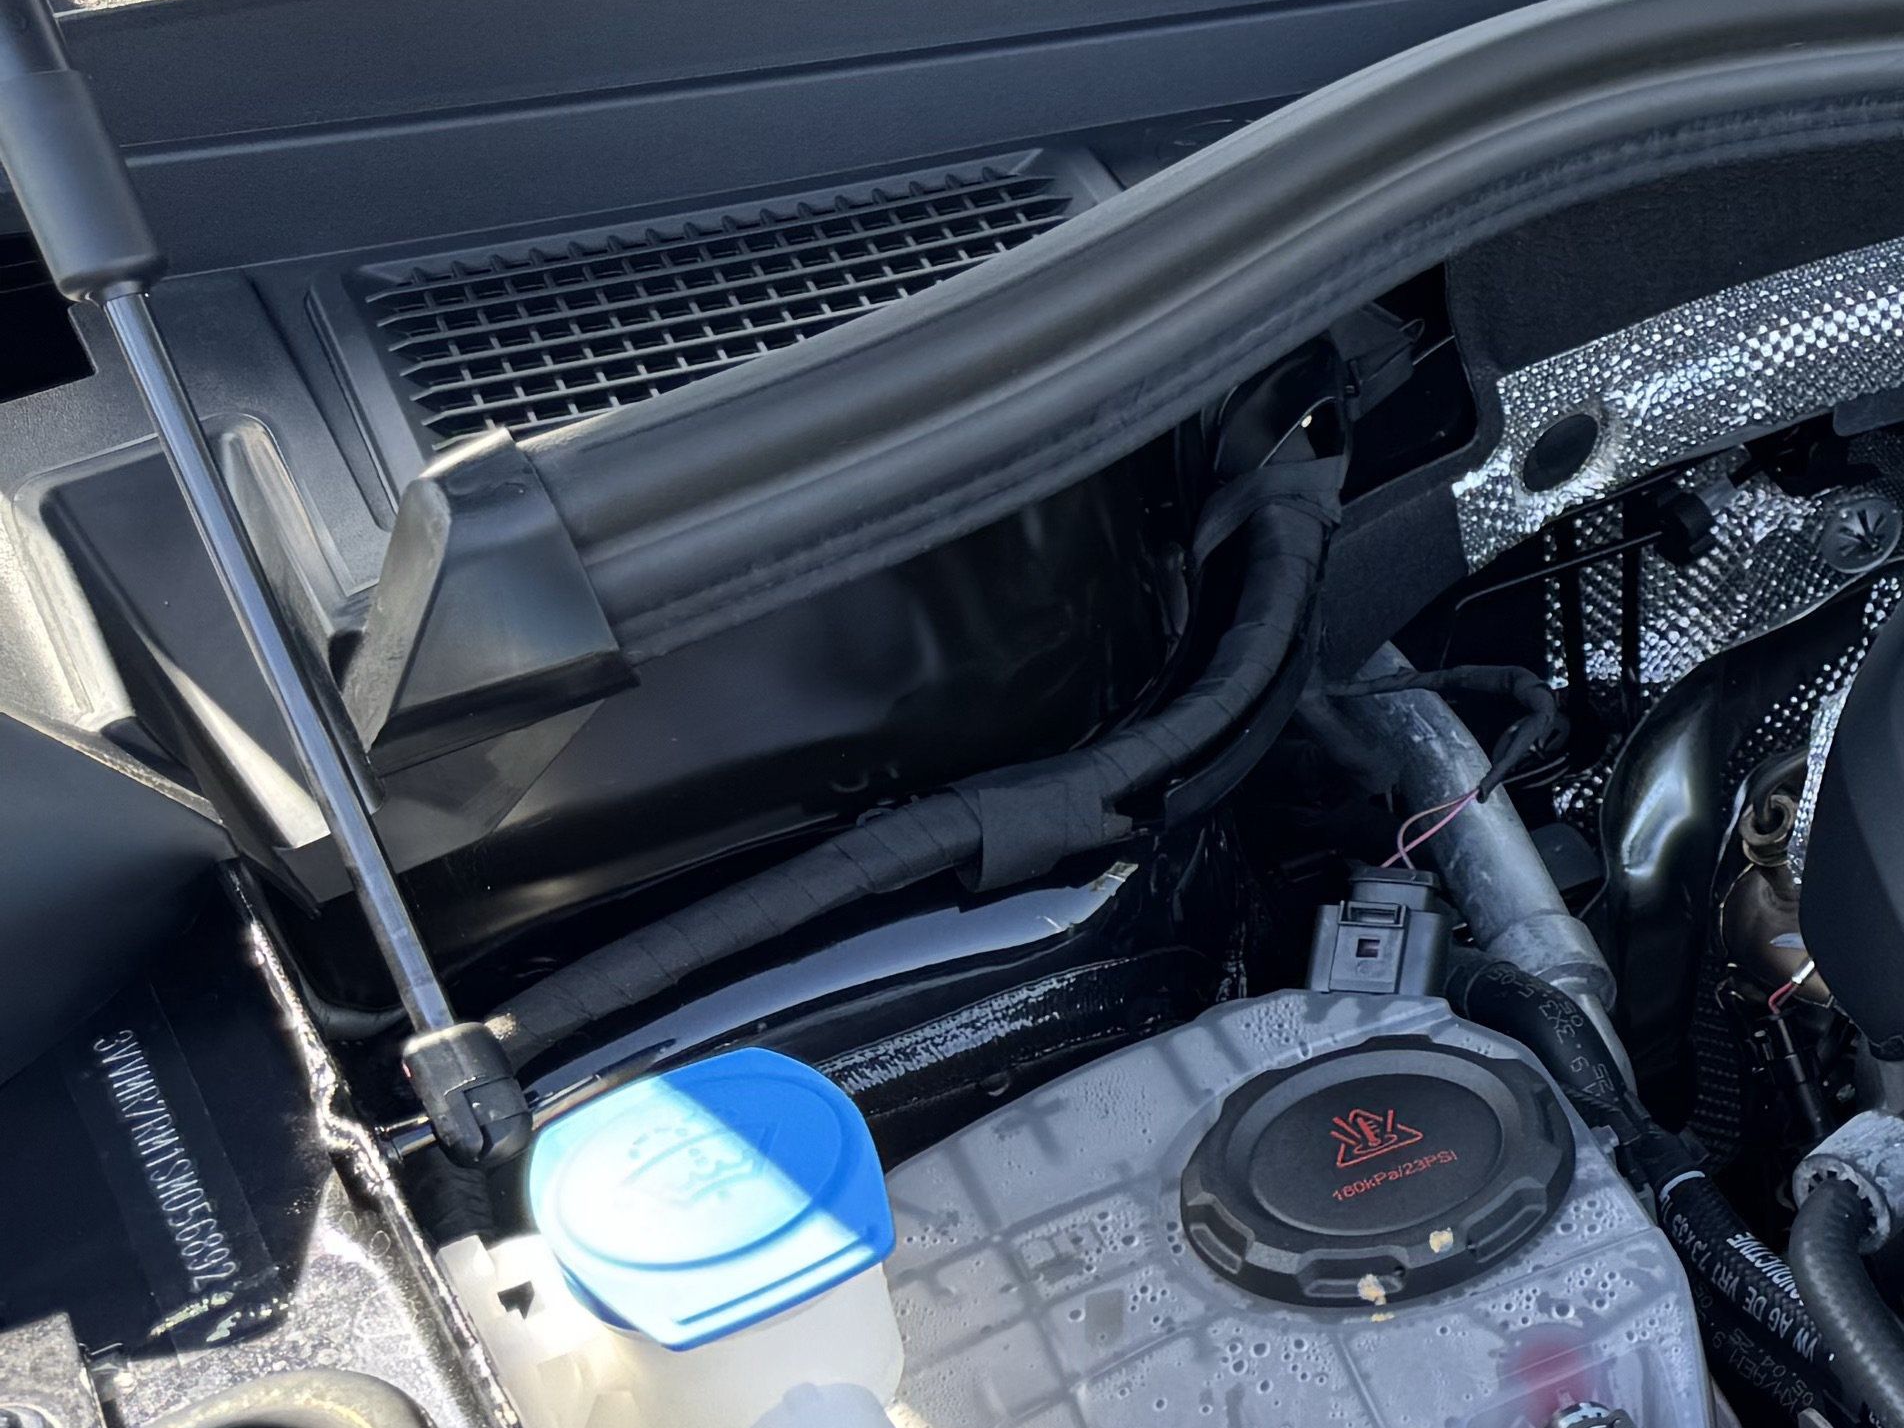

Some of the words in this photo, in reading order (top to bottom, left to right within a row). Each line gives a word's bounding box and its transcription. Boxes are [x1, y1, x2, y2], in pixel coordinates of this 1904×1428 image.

[95, 1030, 237, 1290] 3VVMR7RM1SM056892
[1736, 1286, 1769, 1318] DE
[1763, 1306, 1794, 1335] AG
[1788, 1325, 1824, 1362] VW
